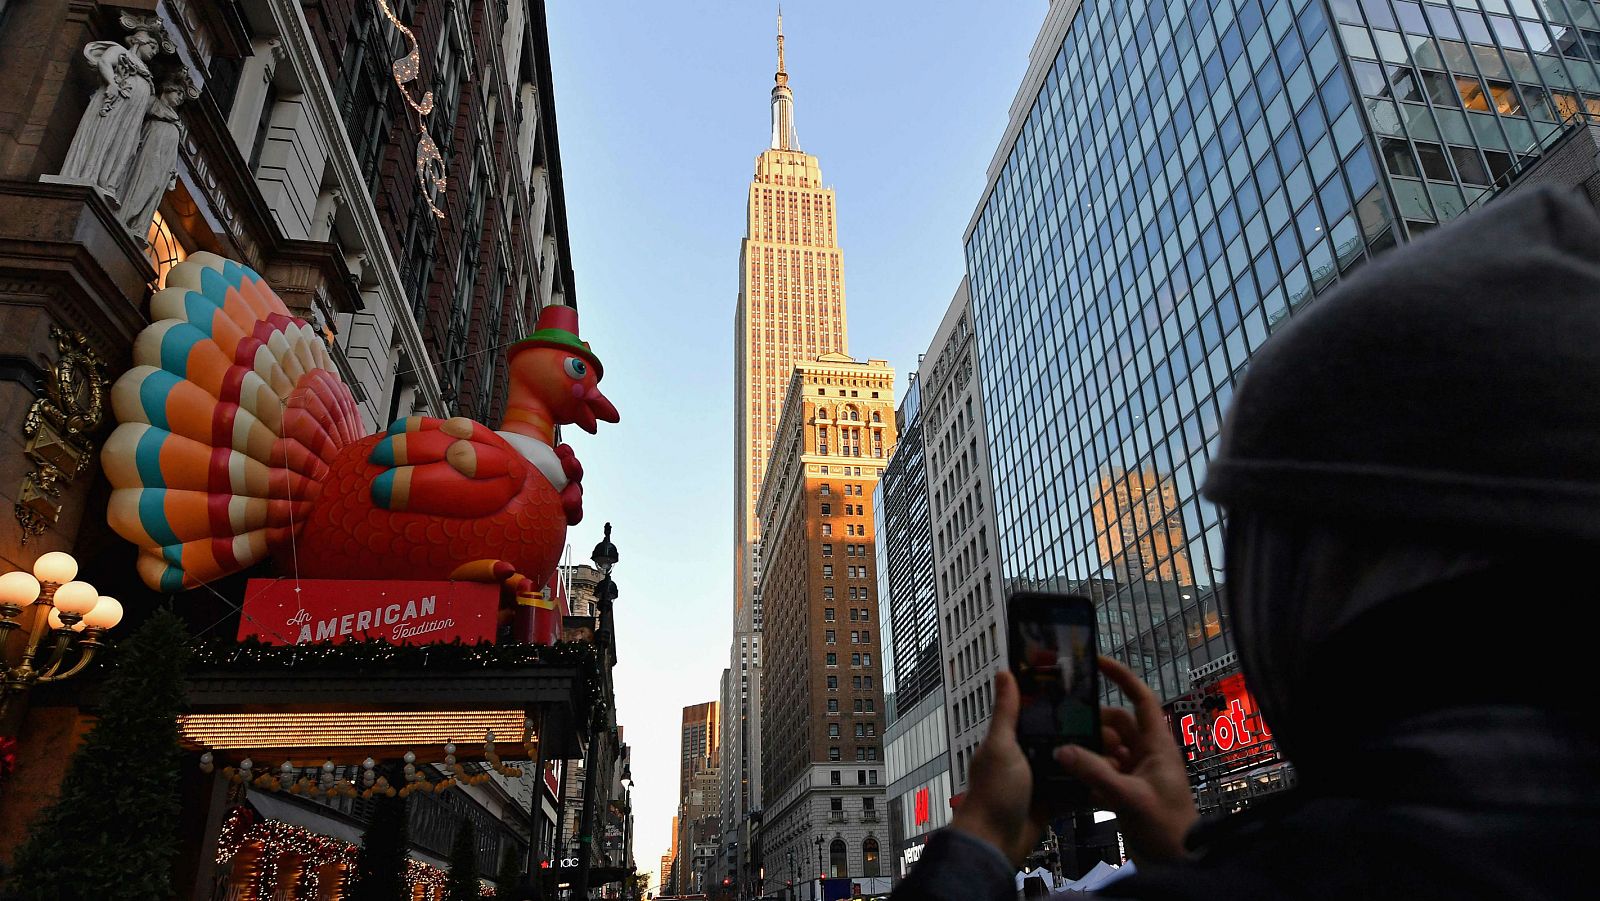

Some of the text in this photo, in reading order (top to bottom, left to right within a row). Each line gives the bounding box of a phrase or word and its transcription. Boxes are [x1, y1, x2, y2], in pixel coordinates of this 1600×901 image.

[286, 608, 313, 627] An
[296, 596, 437, 644] AMERICAN
[392, 616, 455, 641] Tradition
